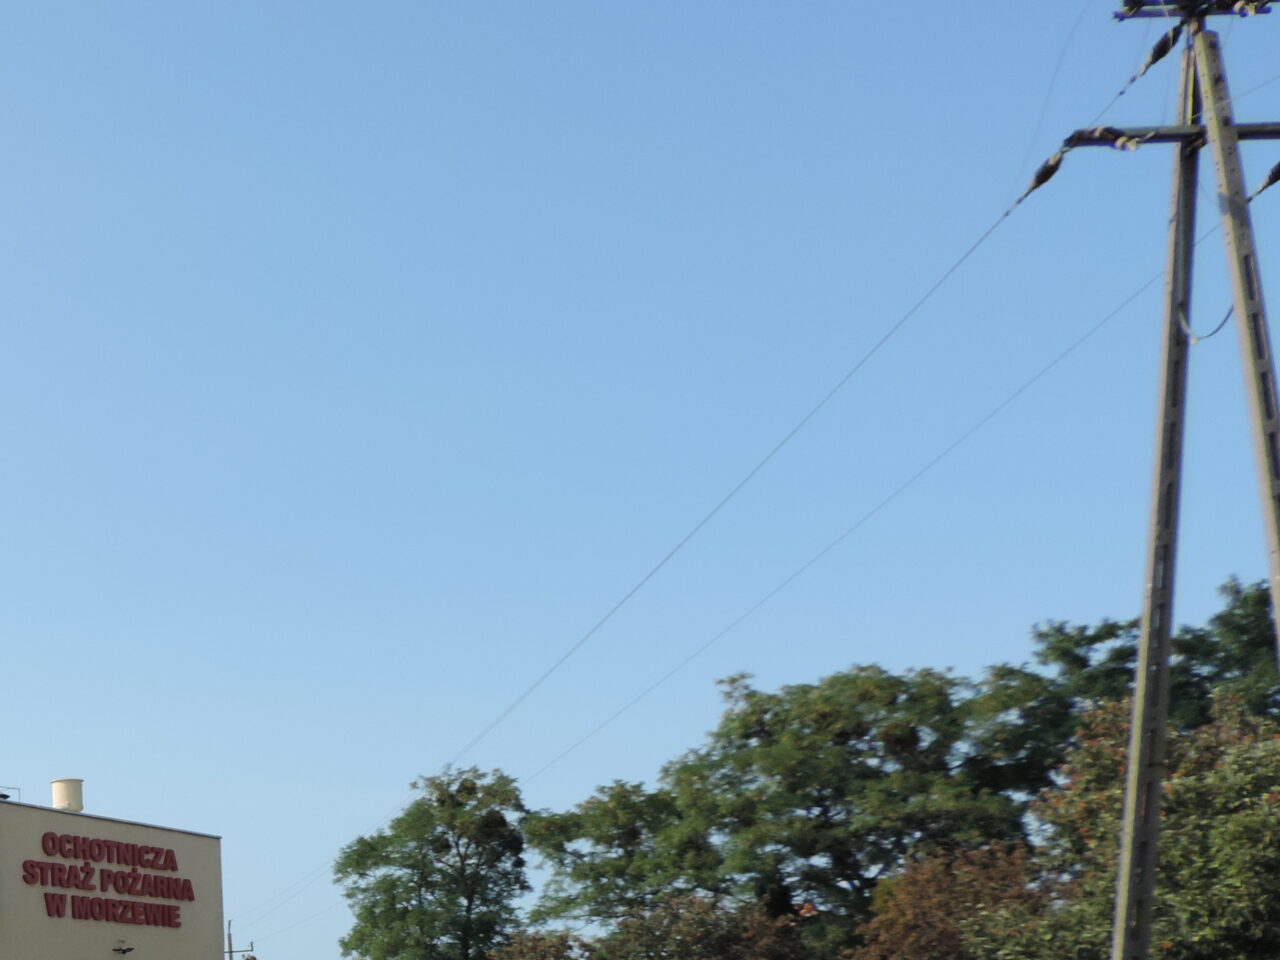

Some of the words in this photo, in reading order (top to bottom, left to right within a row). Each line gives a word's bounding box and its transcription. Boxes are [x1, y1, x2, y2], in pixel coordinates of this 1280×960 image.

[42, 832, 178, 871] OCHOTNICZA
[22, 860, 96, 890] STRAŻ
[100, 868, 195, 901] POŻARNA
[44, 893, 67, 917] W
[71, 895, 182, 928] MORZEWIE
